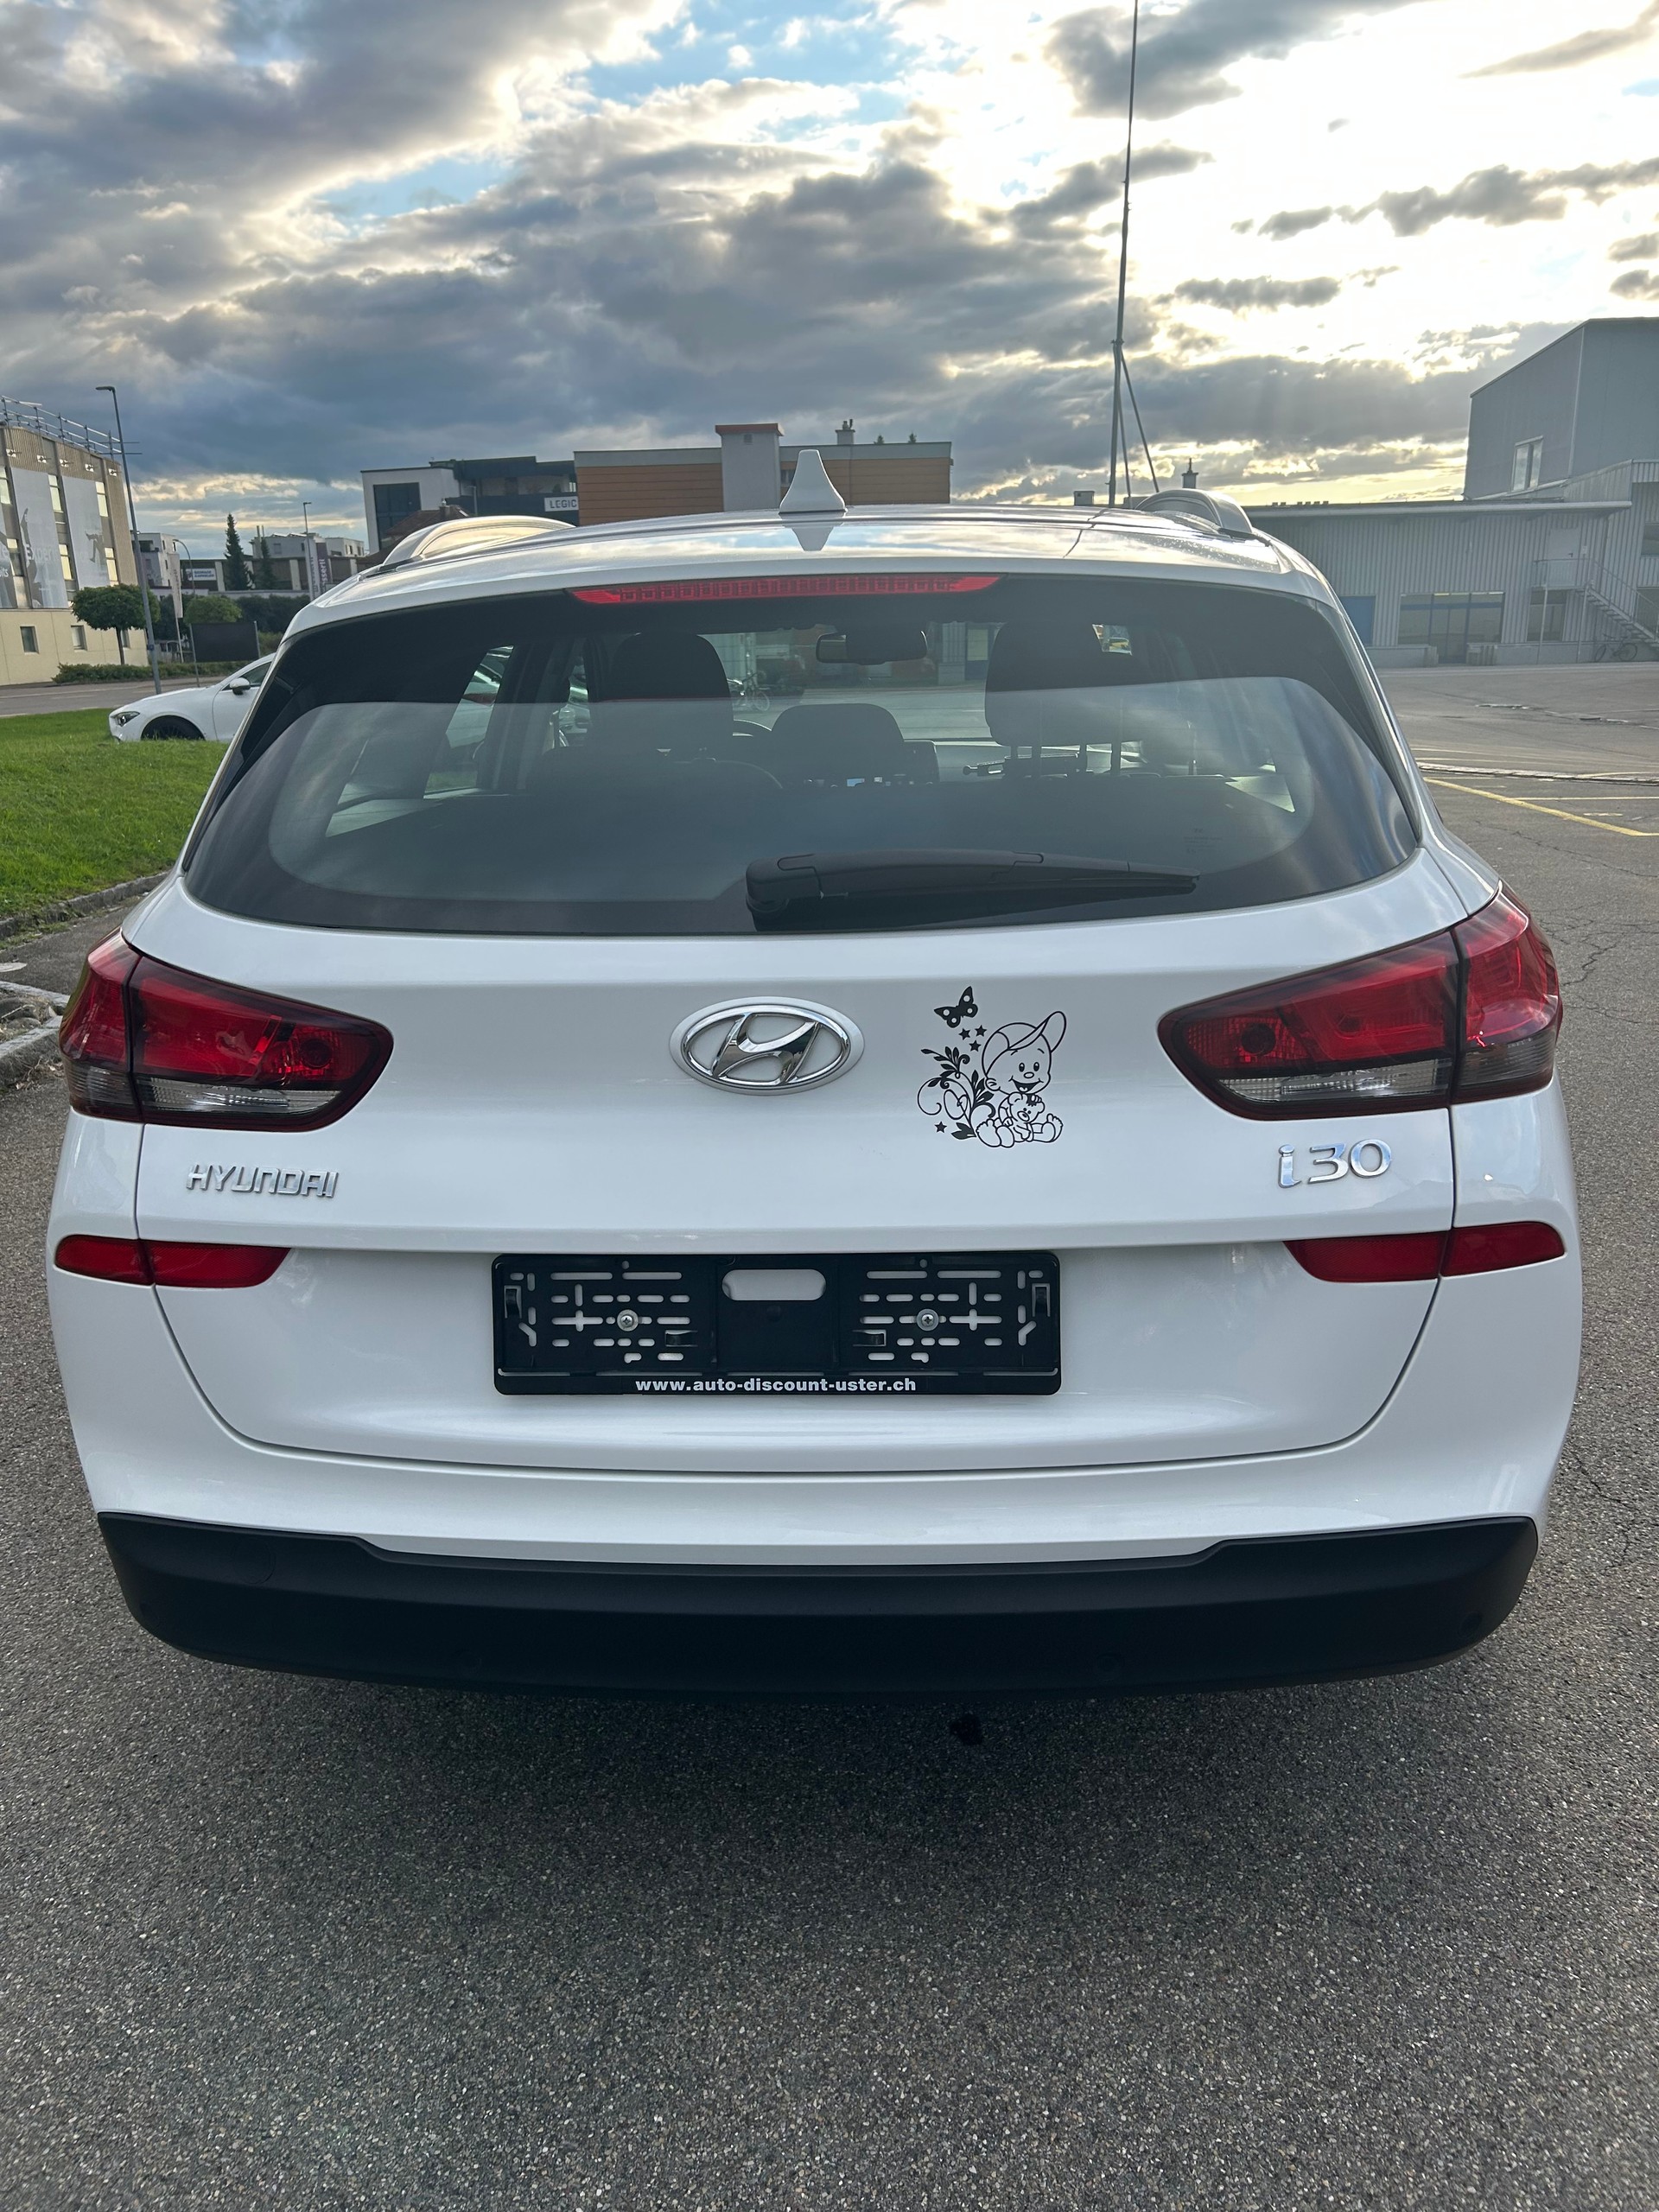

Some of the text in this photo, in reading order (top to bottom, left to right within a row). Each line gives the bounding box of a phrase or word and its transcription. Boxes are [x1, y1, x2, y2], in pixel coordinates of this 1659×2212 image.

[550, 499, 577, 509] LEGIC
[1278, 1139, 1392, 1188] i30
[186, 1164, 339, 1198] HYUNDAI
[635, 1377, 916, 1391] www.auto-discount-uster.ch
